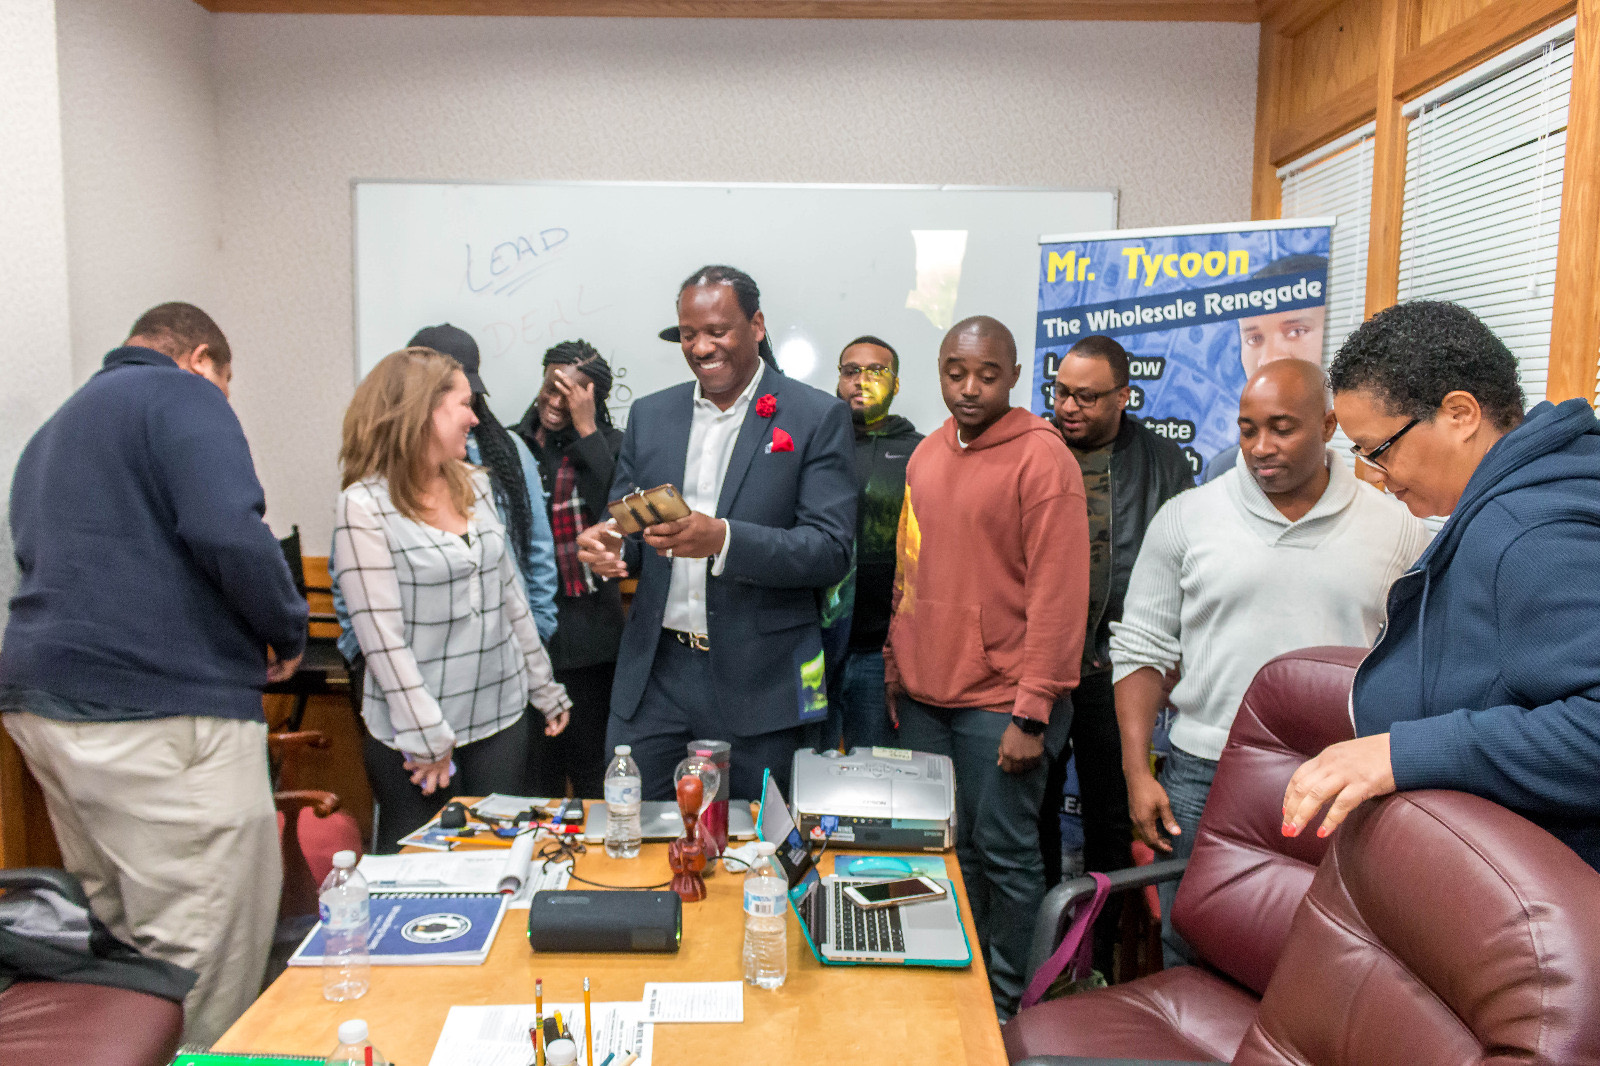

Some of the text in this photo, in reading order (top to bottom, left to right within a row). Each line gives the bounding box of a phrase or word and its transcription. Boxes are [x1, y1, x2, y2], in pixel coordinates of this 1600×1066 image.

[466, 227, 569, 292] LEAD
[1047, 247, 1250, 287] Mr. Tycoon
[1042, 278, 1322, 339] The Wholesale Renegade
[1128, 359, 1161, 376] ow
[1144, 420, 1192, 440] tate
